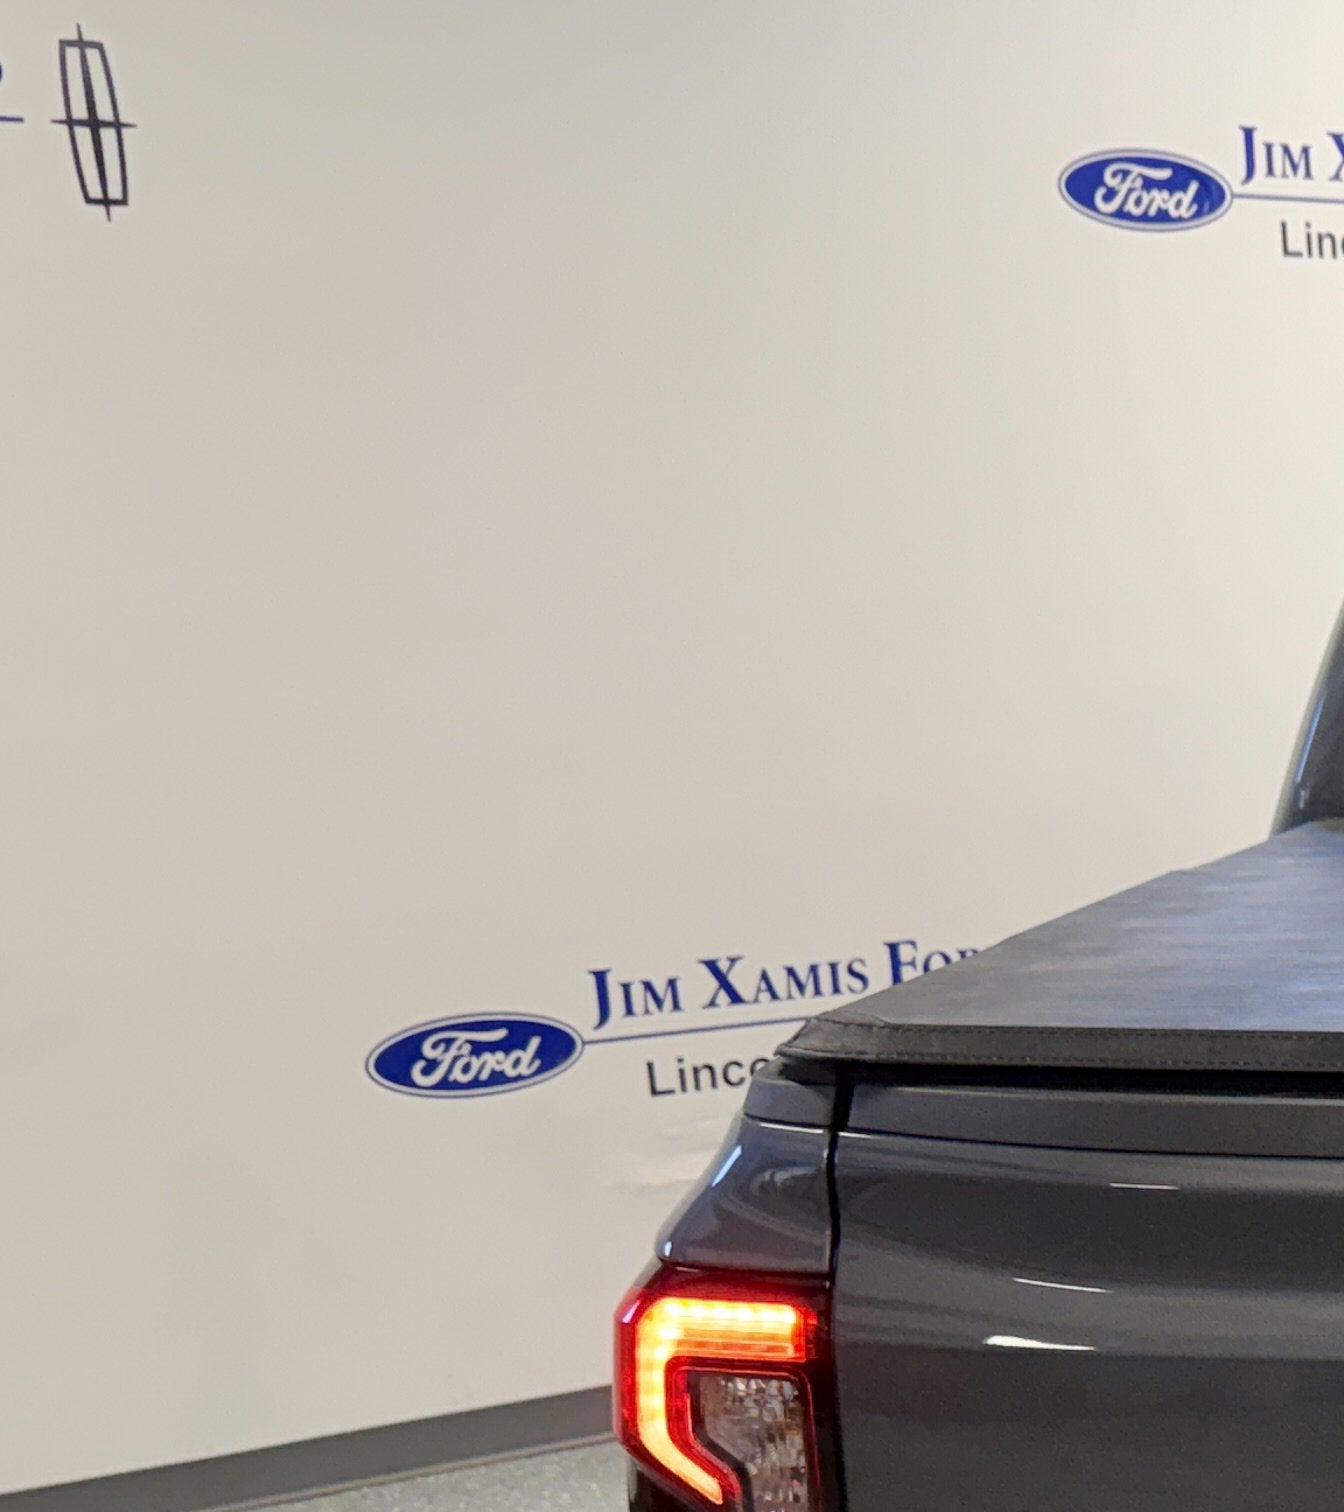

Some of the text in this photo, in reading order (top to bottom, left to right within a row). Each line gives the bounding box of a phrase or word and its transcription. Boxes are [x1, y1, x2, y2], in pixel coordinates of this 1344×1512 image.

[1239, 125, 1313, 185] JIM
[1092, 160, 1199, 222] Ford
[588, 968, 682, 1030] JIM
[698, 956, 868, 1010] XAMIS
[413, 1028, 540, 1086] Ford
